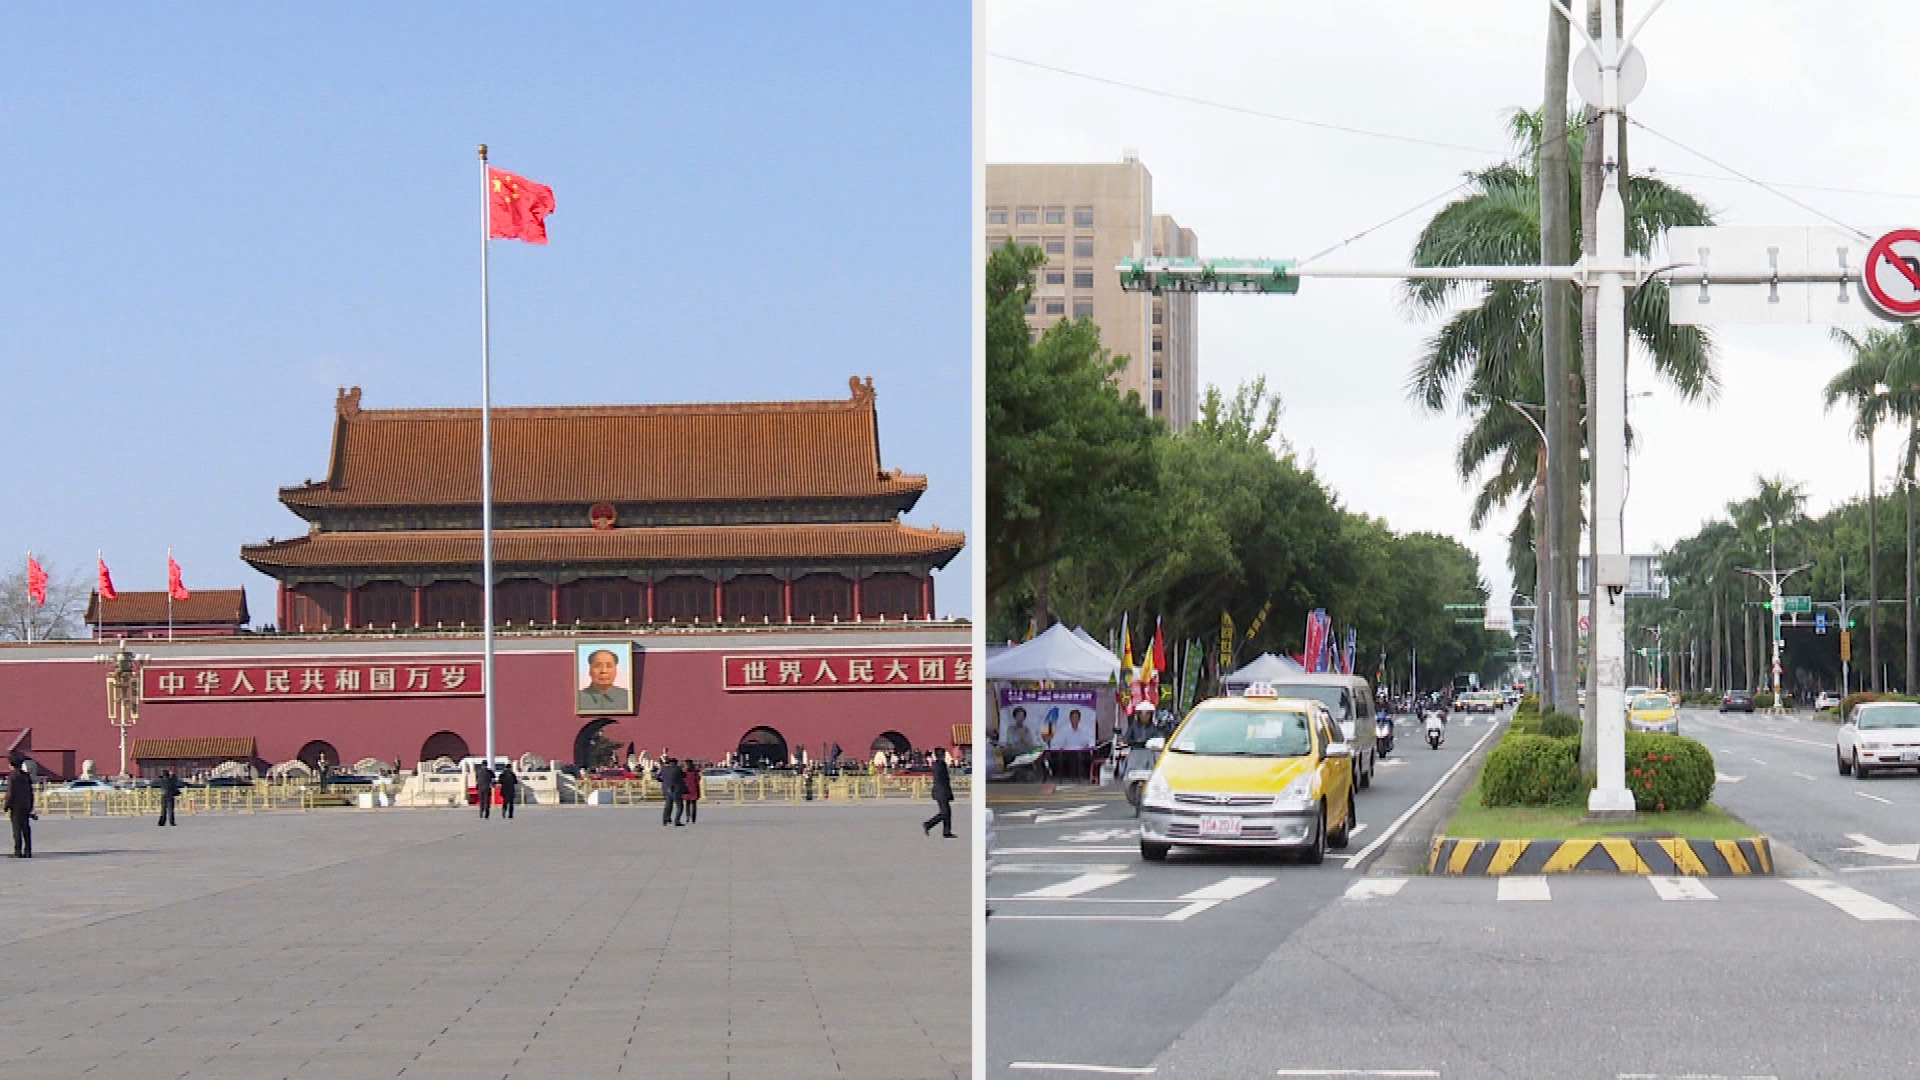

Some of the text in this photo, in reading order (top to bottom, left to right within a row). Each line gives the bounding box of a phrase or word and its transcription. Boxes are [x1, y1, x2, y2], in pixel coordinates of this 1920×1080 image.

[159, 667, 467, 694] 中华人民共和国万岁
